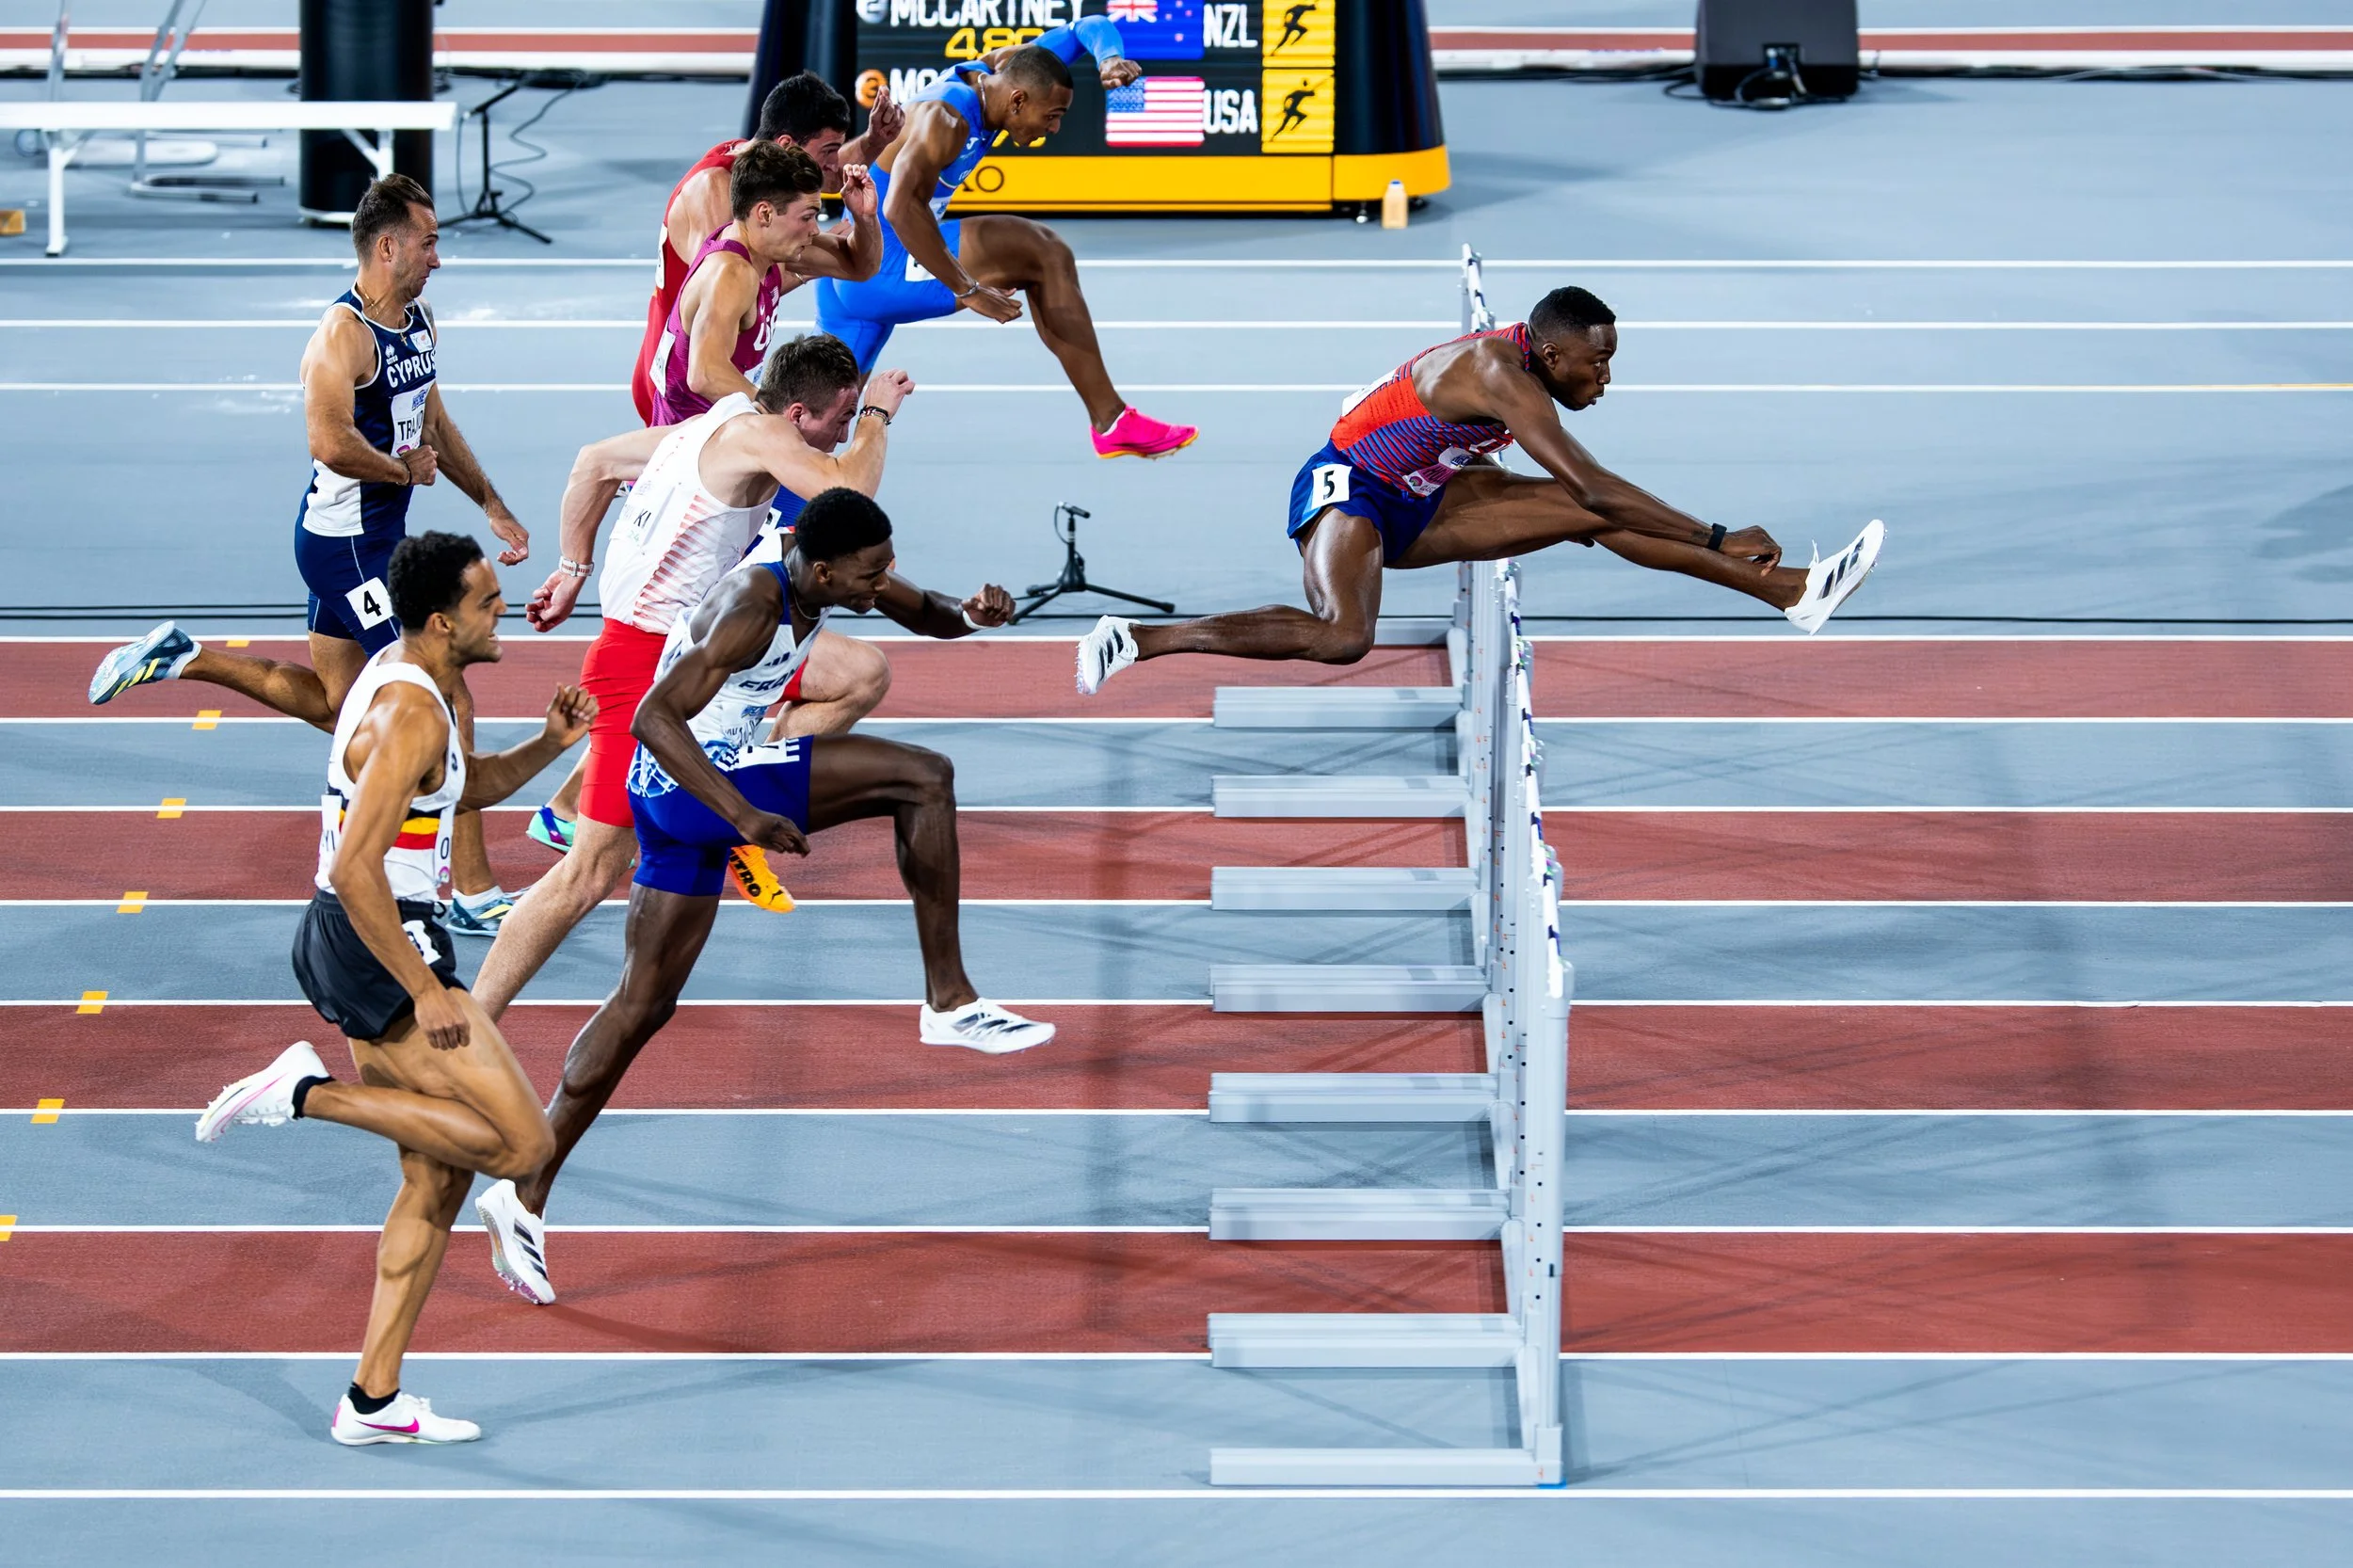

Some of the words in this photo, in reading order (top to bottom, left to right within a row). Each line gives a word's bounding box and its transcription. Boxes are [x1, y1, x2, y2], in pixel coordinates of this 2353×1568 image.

[1203, 4, 1258, 48] NZL
[1203, 89, 1258, 134] USA
[386, 350, 437, 389] CYPRUS
[1322, 470, 1336, 500] 5
[363, 590, 382, 617] 4
